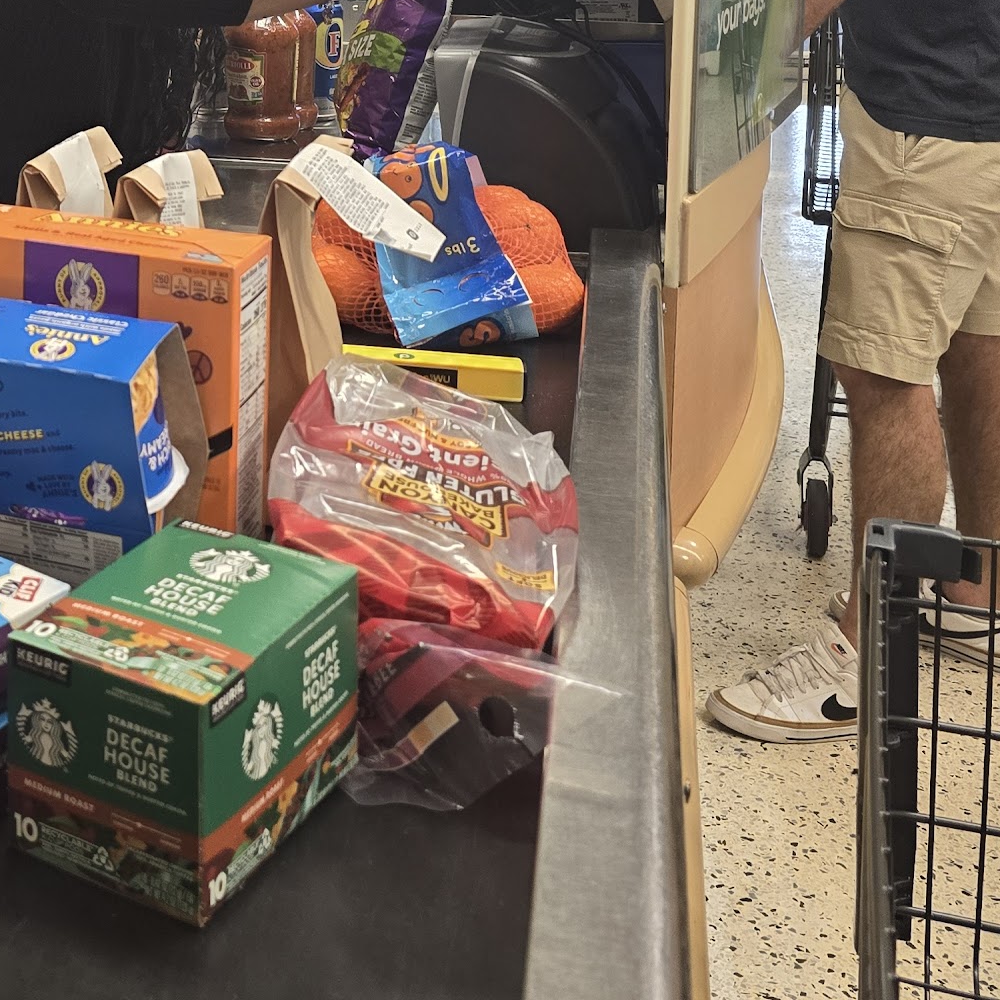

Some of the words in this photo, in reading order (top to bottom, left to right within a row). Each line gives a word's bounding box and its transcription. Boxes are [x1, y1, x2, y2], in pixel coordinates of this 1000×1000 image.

[717, 1, 741, 50] your
[348, 34, 376, 61] SIZE
[32, 213, 182, 237] Annie's
[445, 239, 464, 256] lbs
[466, 236, 480, 253] 3
[24, 322, 110, 346] Annie's
[366, 438, 403, 460] BREAD
[378, 478, 496, 532] CANYON
[180, 520, 235, 538] KEURIG
[14, 576, 41, 602] CLIF
[144, 585, 225, 614] HOUSE
[156, 578, 232, 606] DECAF
[149, 597, 199, 618] BLEND
[24, 620, 58, 638] 10
[16, 648, 68, 677] KEURIG
[302, 639, 340, 684] DECAF
[302, 659, 340, 708] HOUSE
[212, 680, 244, 720] KEURIG
[310, 688, 335, 718] BLEND
[107, 714, 170, 744] STARBUCKS
[106, 727, 170, 763] DECAF
[103, 748, 172, 785] HOUSE
[24, 778, 62, 801] MEDIUM
[64, 791, 96, 812] ROAST
[116, 769, 158, 794] BLEND
[14, 811, 40, 843] 10
[208, 872, 226, 906] 10
